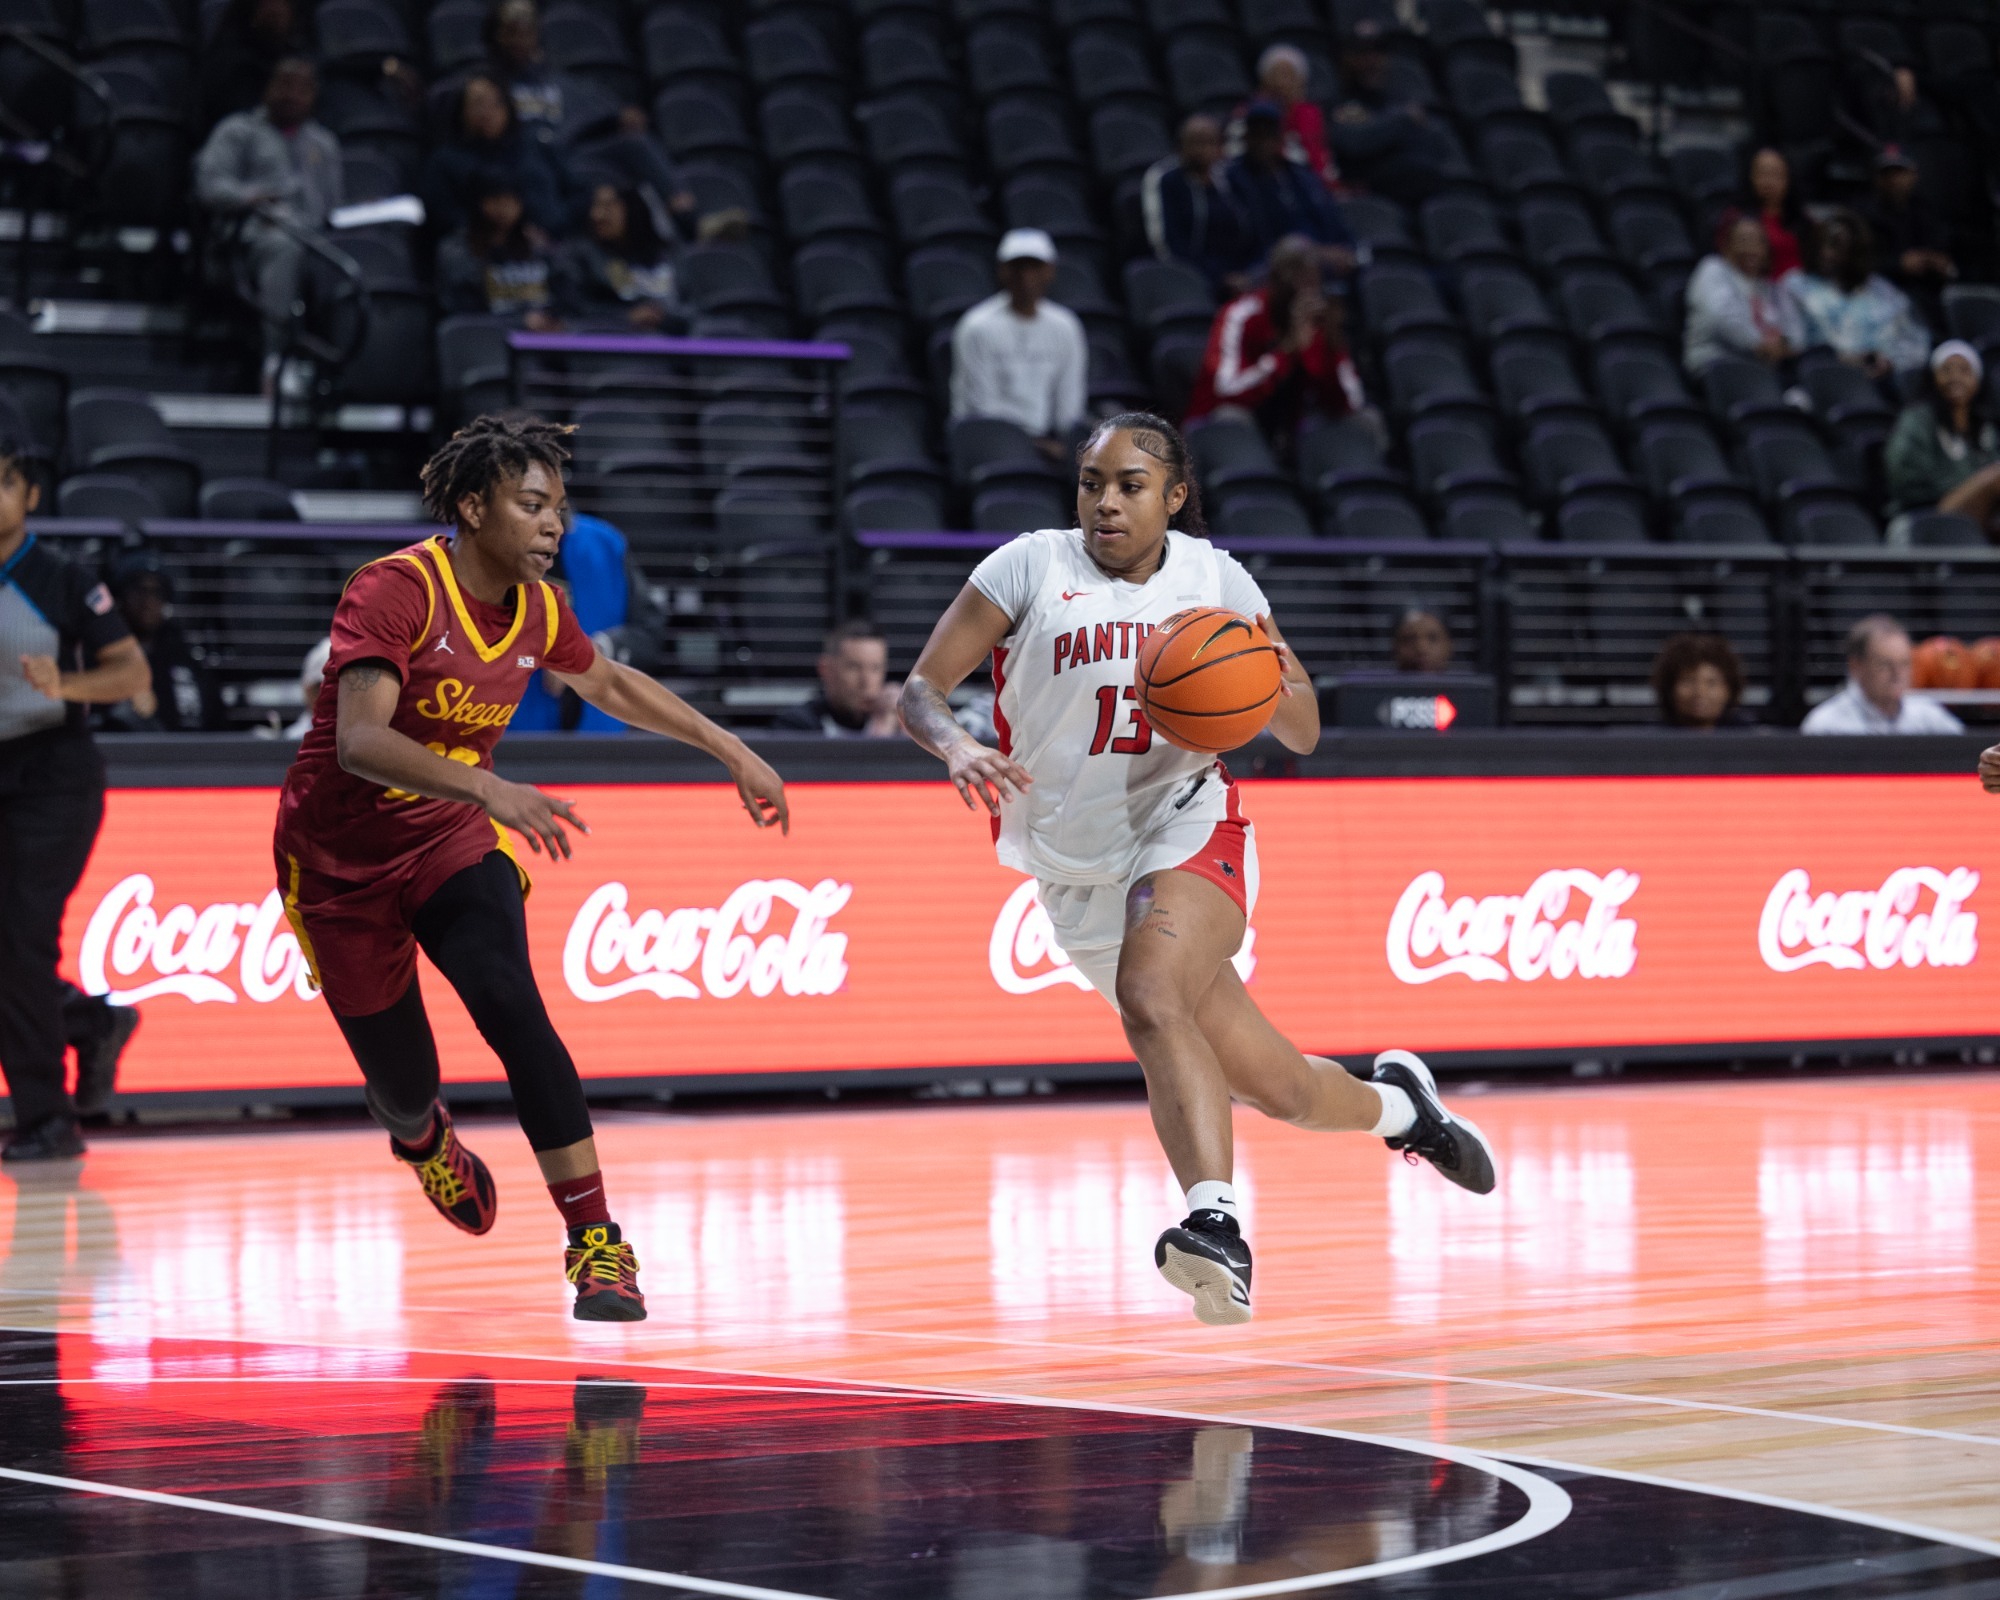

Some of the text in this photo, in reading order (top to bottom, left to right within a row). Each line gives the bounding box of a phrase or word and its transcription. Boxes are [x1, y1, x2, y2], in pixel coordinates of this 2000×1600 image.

[1053, 621, 1155, 676] PANTH
[1088, 685, 1152, 756] 13
[79, 873, 322, 1006] Coca-C
